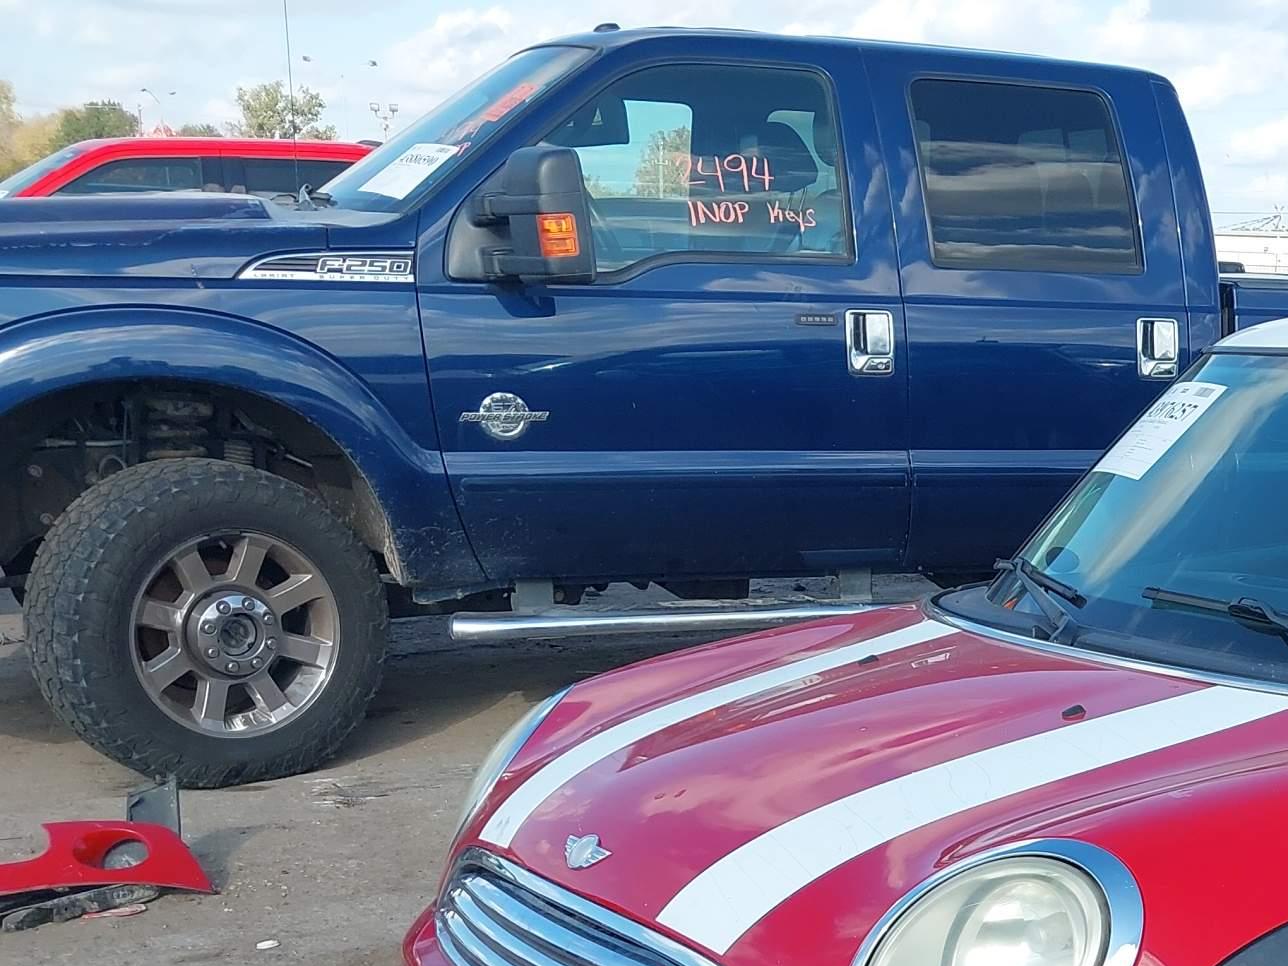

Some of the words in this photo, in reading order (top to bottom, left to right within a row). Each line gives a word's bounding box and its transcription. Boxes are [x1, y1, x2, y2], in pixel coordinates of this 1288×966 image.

[676, 154, 774, 192] 2494
[687, 200, 749, 227] INOP
[316, 257, 411, 274] F-250
[461, 412, 500, 421] POWER
[502, 412, 548, 421] STROKE
